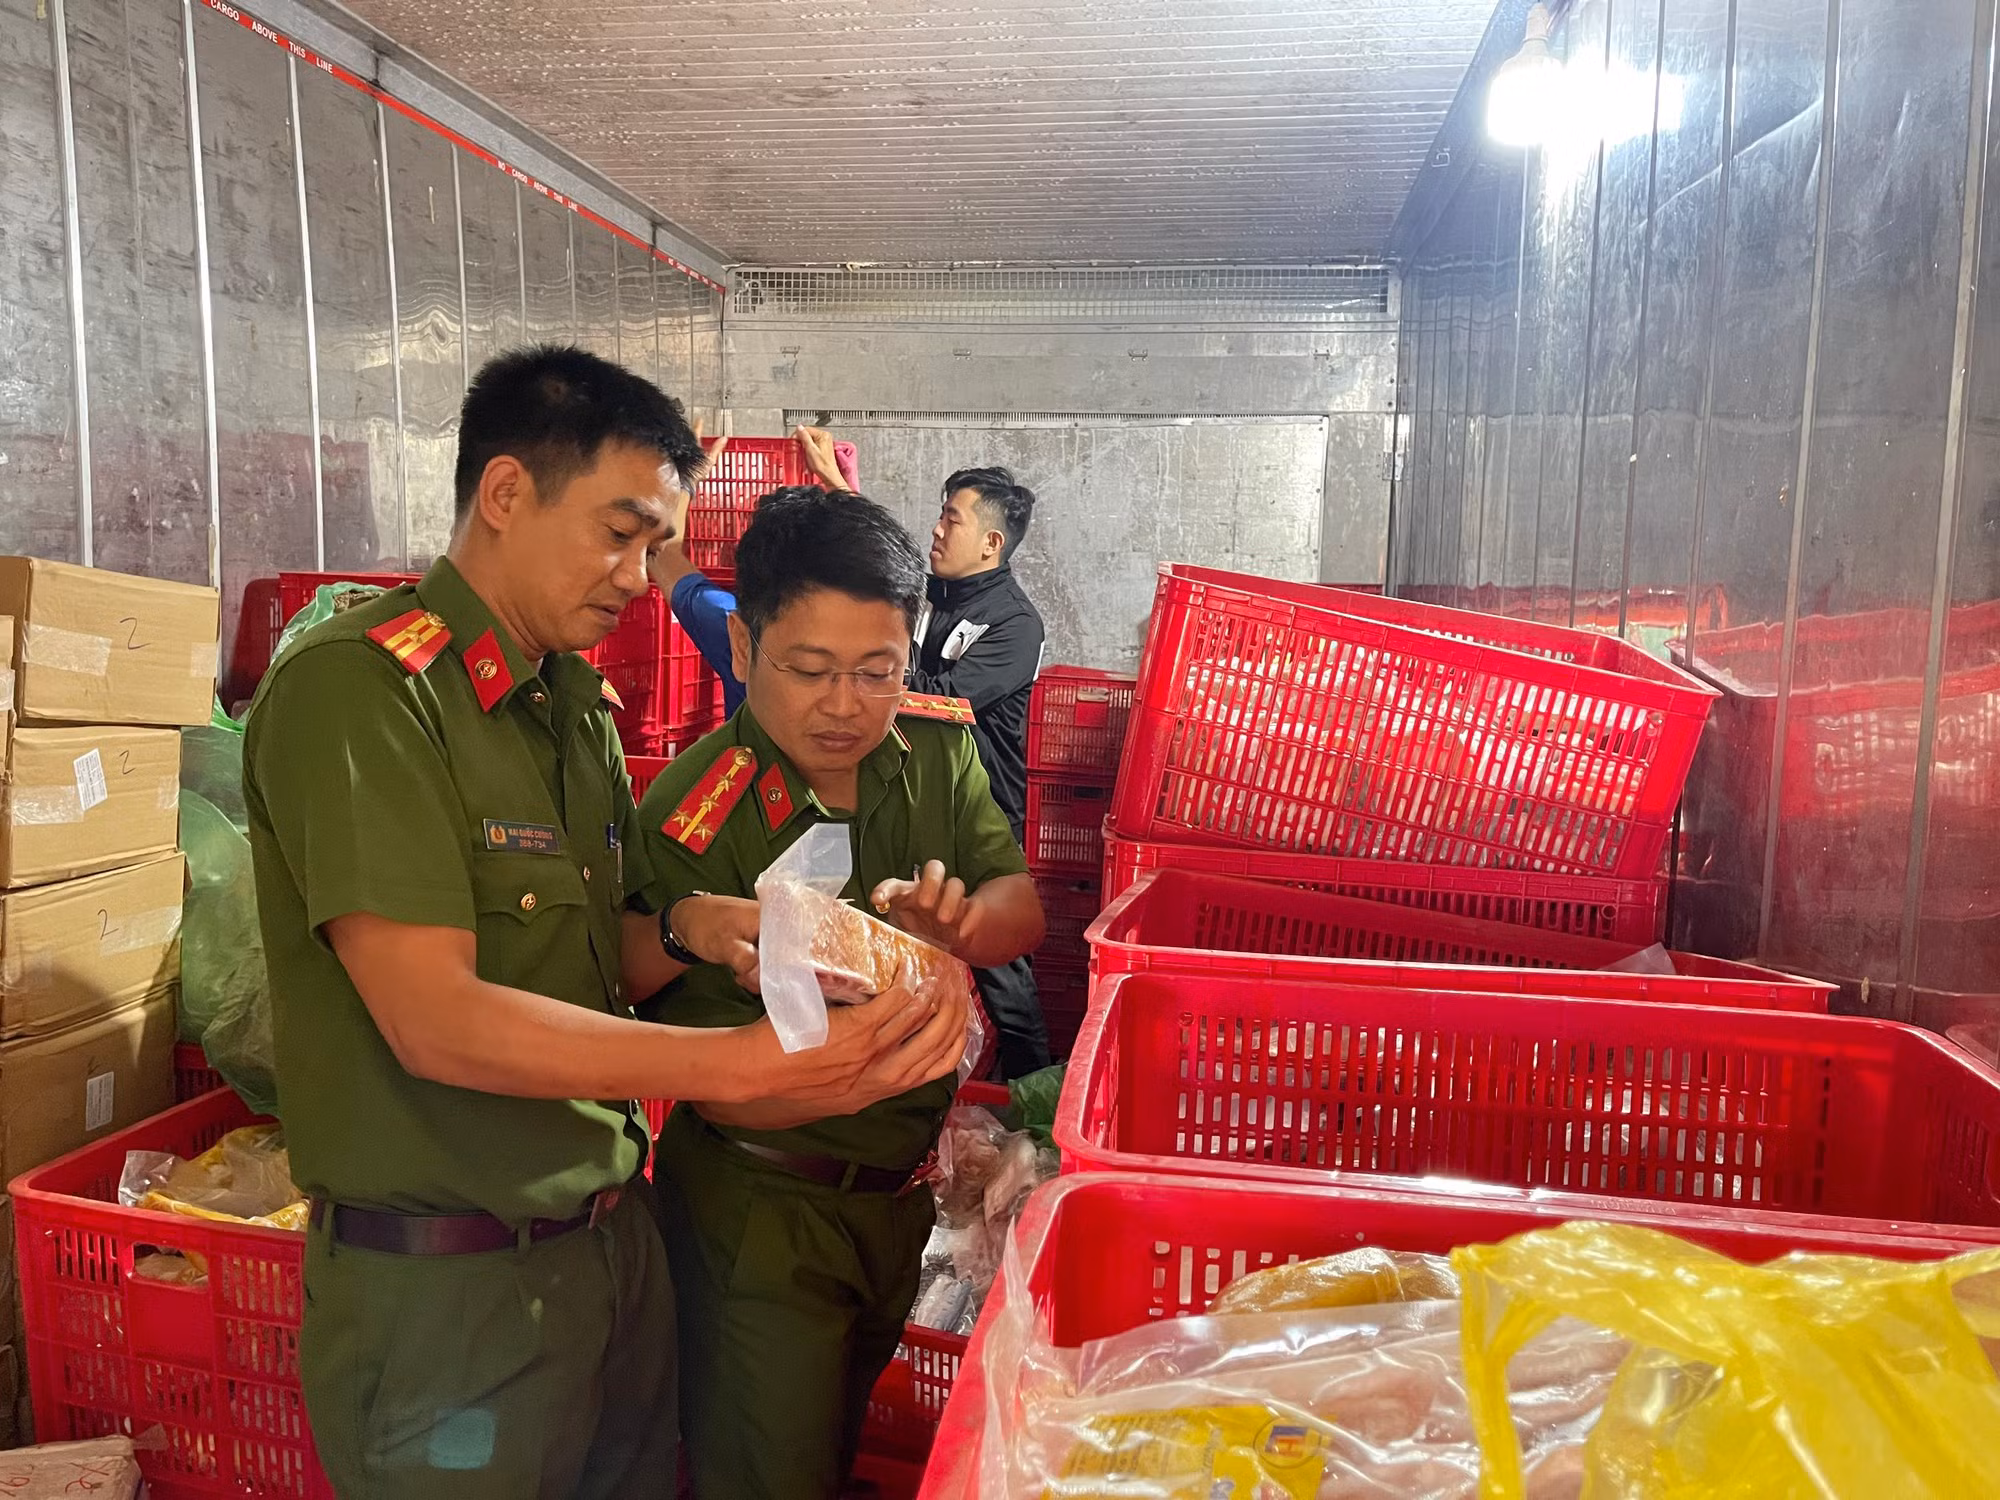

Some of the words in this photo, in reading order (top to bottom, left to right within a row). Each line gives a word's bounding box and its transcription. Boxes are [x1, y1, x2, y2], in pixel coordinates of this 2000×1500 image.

[210, 0, 240, 21] CARGO
[252, 21, 278, 43] ABOVE
[288, 41, 306, 58] THIS
[316, 57, 334, 74] LINE
[119, 617, 151, 650] 2
[119, 750, 136, 775] 2
[97, 908, 119, 941] 2
